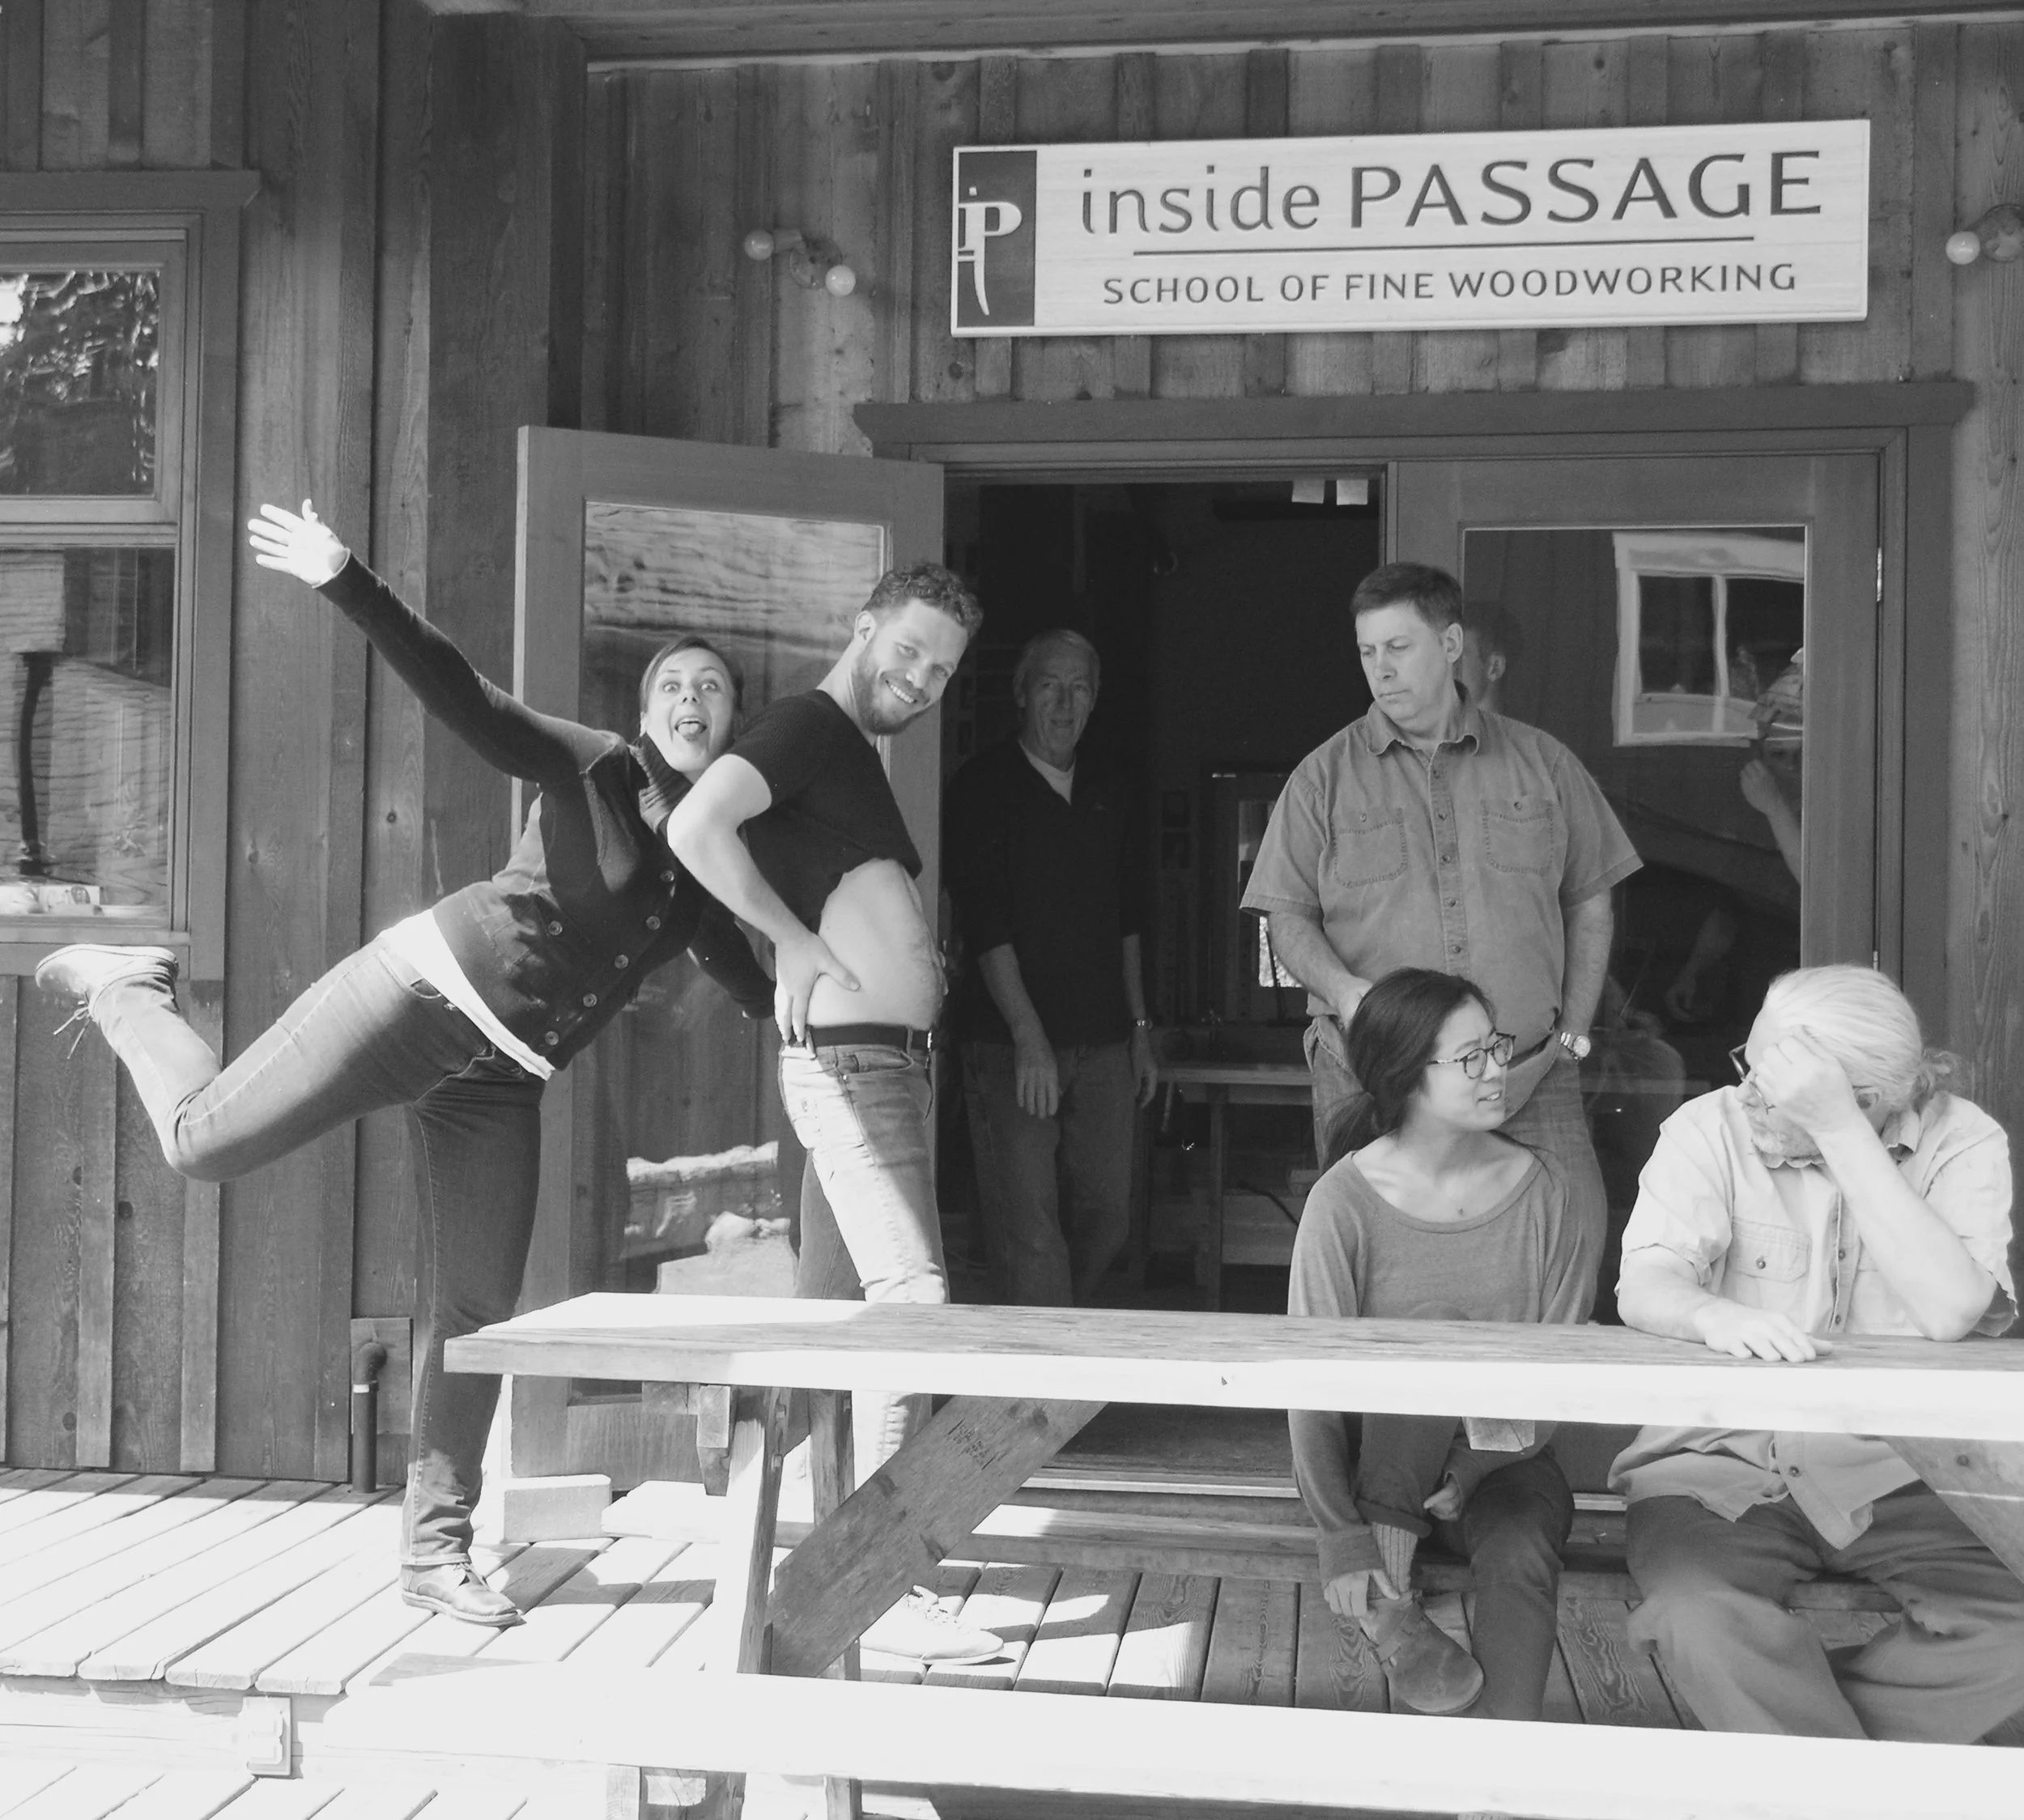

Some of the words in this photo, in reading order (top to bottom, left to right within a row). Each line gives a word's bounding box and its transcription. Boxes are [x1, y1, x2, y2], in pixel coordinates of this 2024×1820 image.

[1082, 164, 1320, 234] inside
[1350, 150, 1822, 228] PASSAGE
[1103, 276, 1264, 304] SCHOOL
[1280, 274, 1329, 302] OF
[1346, 273, 1434, 300] FINE
[1448, 263, 1795, 298] WOODWORKING
